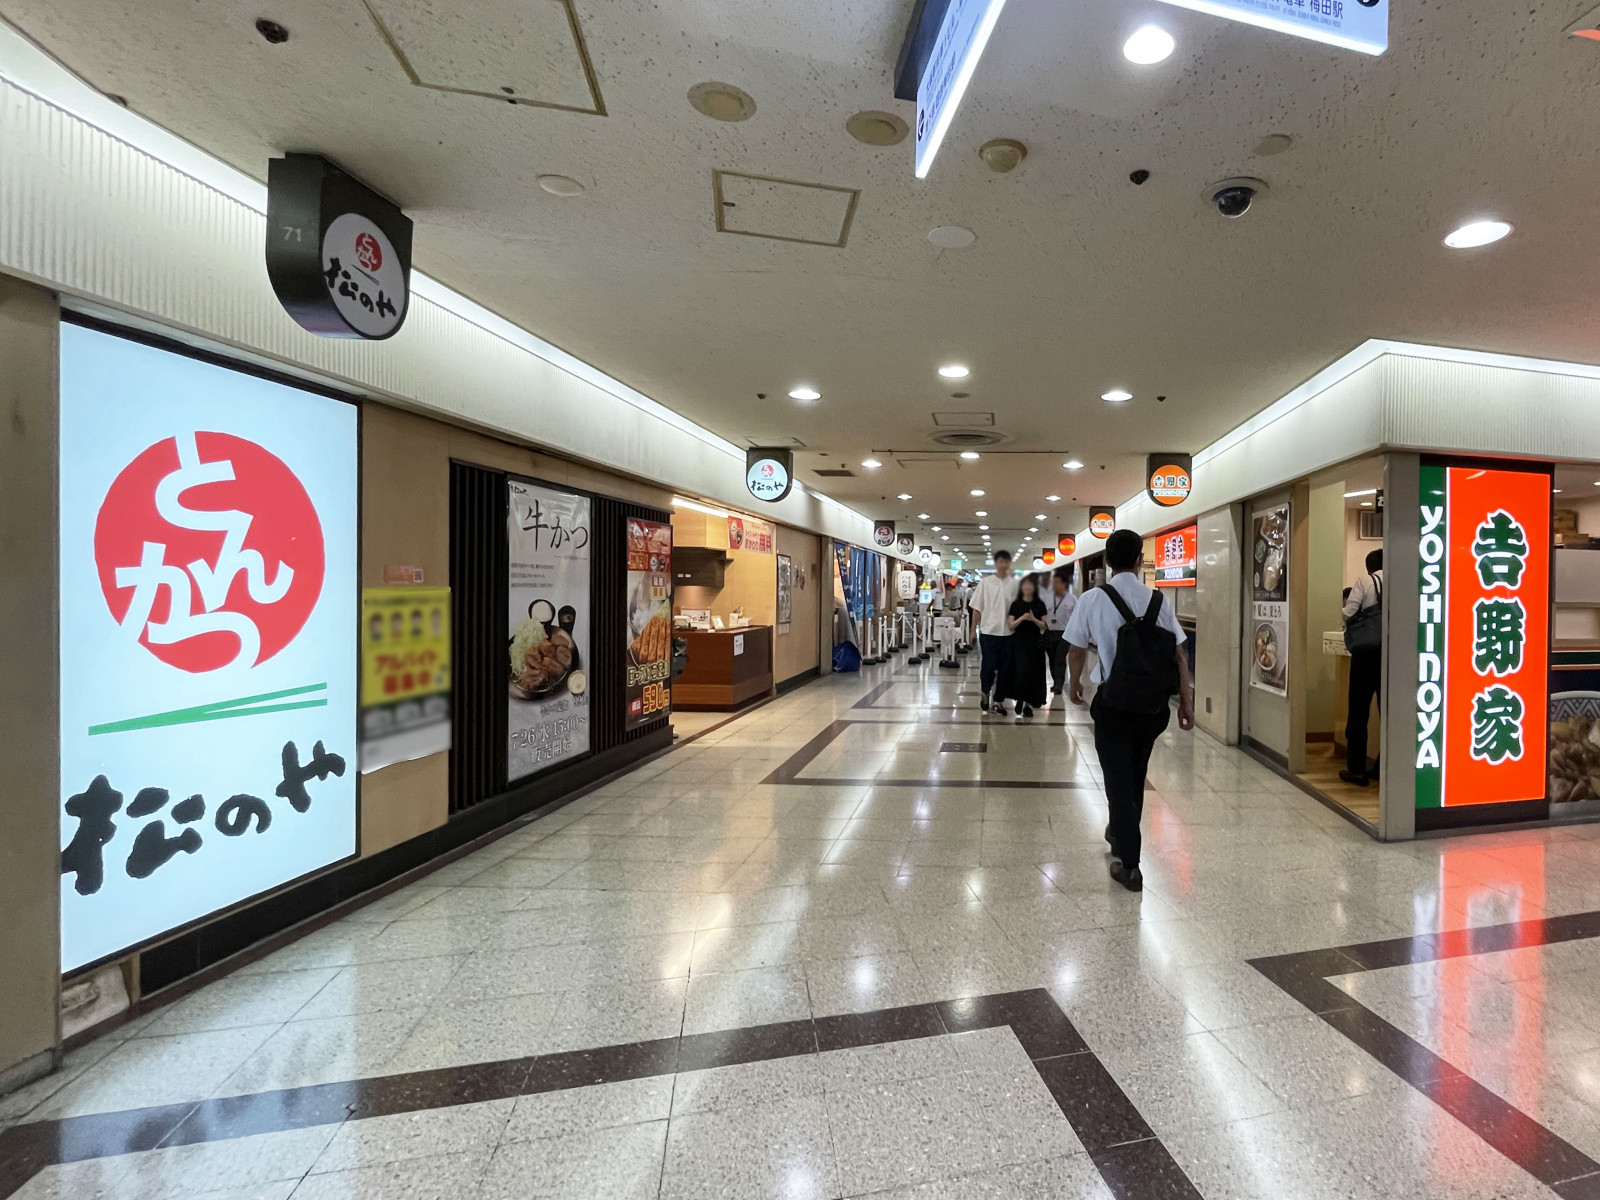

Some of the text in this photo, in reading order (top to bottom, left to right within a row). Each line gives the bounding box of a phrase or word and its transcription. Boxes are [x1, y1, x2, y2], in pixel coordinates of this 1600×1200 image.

[282, 226, 302, 242] 71
[522, 498, 589, 552] 牛かつ
[1415, 504, 1445, 770] YOSHINOYA
[1469, 508, 1530, 768] 吉野家
